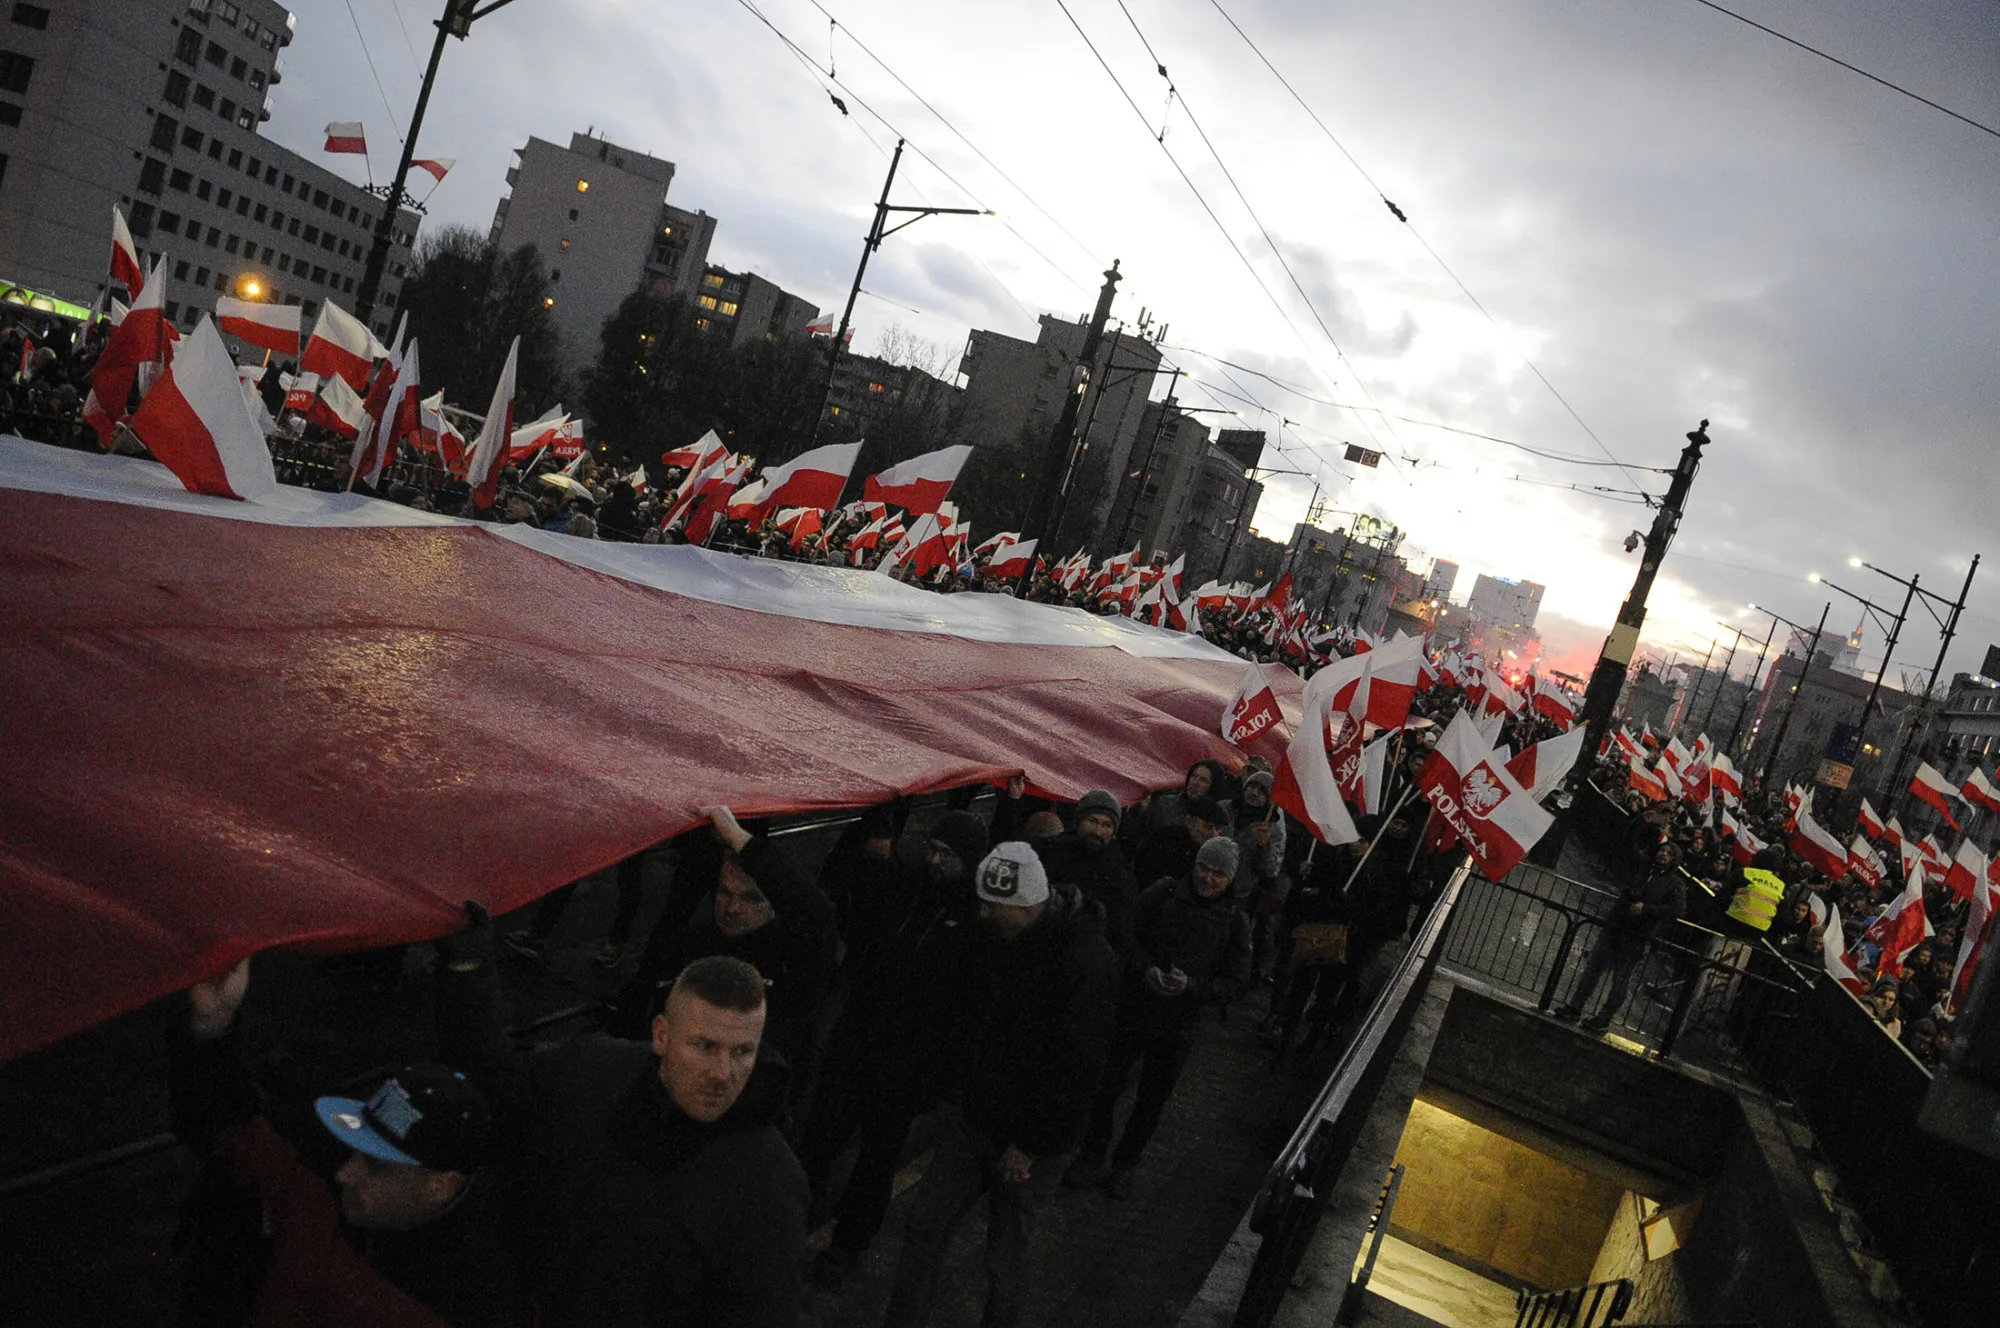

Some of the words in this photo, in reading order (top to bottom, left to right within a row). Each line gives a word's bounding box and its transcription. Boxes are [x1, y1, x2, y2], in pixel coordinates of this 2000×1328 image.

[1365, 453, 1378, 464] 20
[1427, 782, 1488, 860] POLSKA
[1851, 861, 1876, 886] POLSKA
